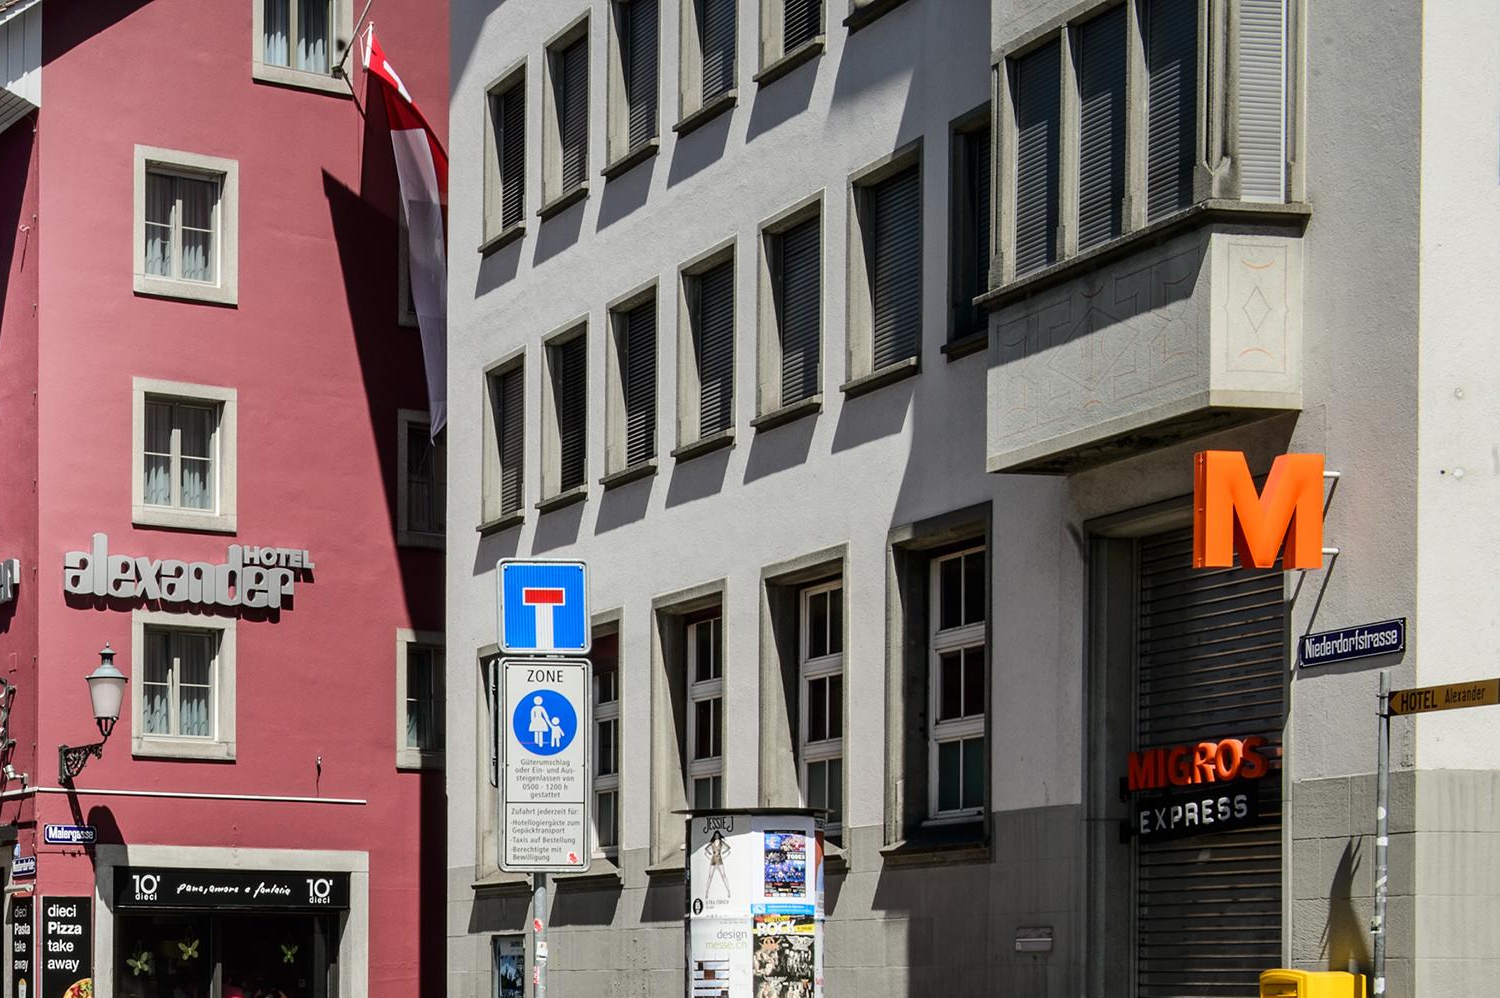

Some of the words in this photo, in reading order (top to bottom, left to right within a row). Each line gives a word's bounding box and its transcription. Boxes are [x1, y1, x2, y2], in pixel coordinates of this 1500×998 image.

[1192, 450, 1325, 569] M
[243, 544, 316, 569] HOTEL
[64, 532, 295, 609] alexander
[1305, 629, 1398, 659] Niederdorfstrasse
[527, 669, 563, 683] ZONE
[1400, 692, 1438, 713] HOTEL
[1444, 684, 1486, 705] Alexander
[520, 758, 570, 767] Güterumschlag
[1127, 736, 1269, 791] MIGROS
[515, 774, 560, 782] steigenlassen
[530, 791, 560, 799] gestattet
[511, 807, 536, 815] Zufahrt
[537, 807, 566, 816] jederzeit
[1139, 795, 1248, 834] EXPRESS
[511, 827, 565, 835] Gepäcktransport
[703, 817, 726, 833] JESSIE
[48, 826, 94, 842] Malergasse
[530, 836, 541, 844] auf
[542, 836, 576, 845] Bestellung
[512, 853, 550, 862] Bewilligung
[135, 892, 158, 901] dieci
[309, 895, 331, 904] dieci
[14, 905, 27, 918] dieci
[47, 904, 77, 917] dieci
[14, 922, 31, 935] Pasta
[47, 921, 82, 935] Pizza
[716, 928, 748, 941] design
[756, 920, 795, 936] ROCK
[14, 940, 26, 952] take
[47, 939, 74, 952] take
[705, 940, 748, 950] messe.ch
[14, 959, 29, 972] away
[47, 959, 79, 973] away
